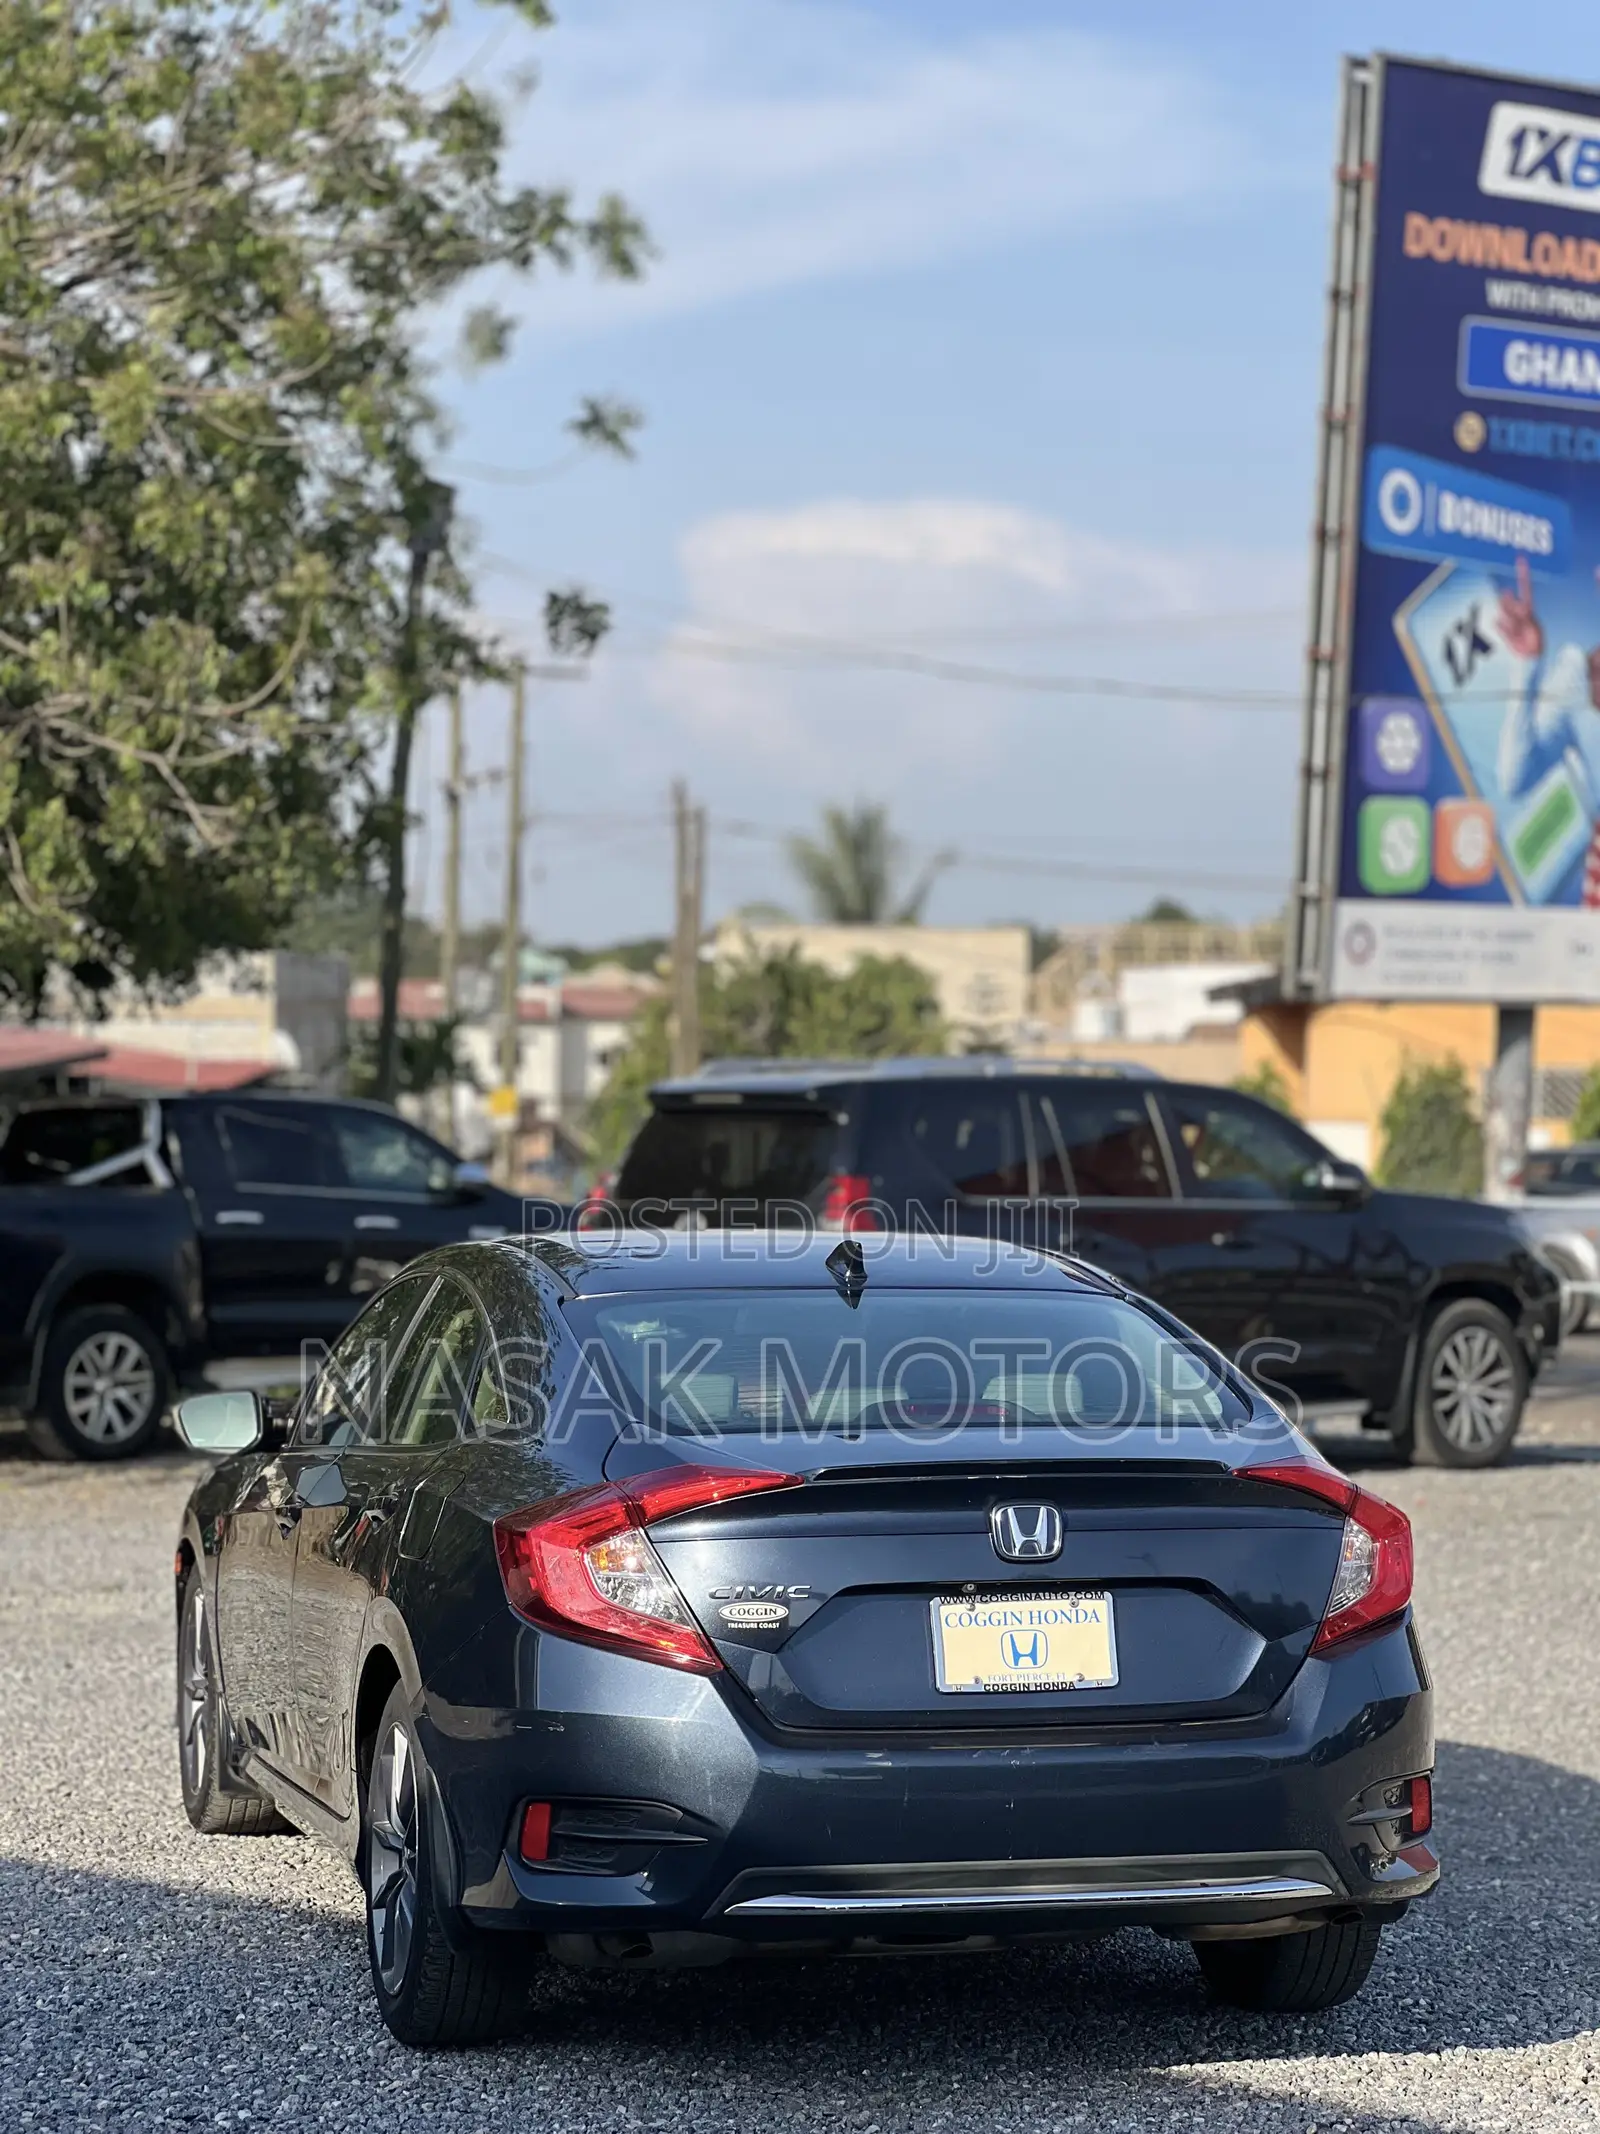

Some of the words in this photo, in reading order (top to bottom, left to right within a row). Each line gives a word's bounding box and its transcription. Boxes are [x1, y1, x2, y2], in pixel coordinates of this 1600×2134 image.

[708, 1585, 812, 1600] CIVIC
[729, 1607, 778, 1616] COGGIN
[945, 1610, 1023, 1628] COGGIN
[1029, 1608, 1101, 1626] HONDA
[988, 1674, 1013, 1683] FORT
[984, 1683, 1030, 1692] COGGIN
[1034, 1681, 1076, 1691] HONDA
